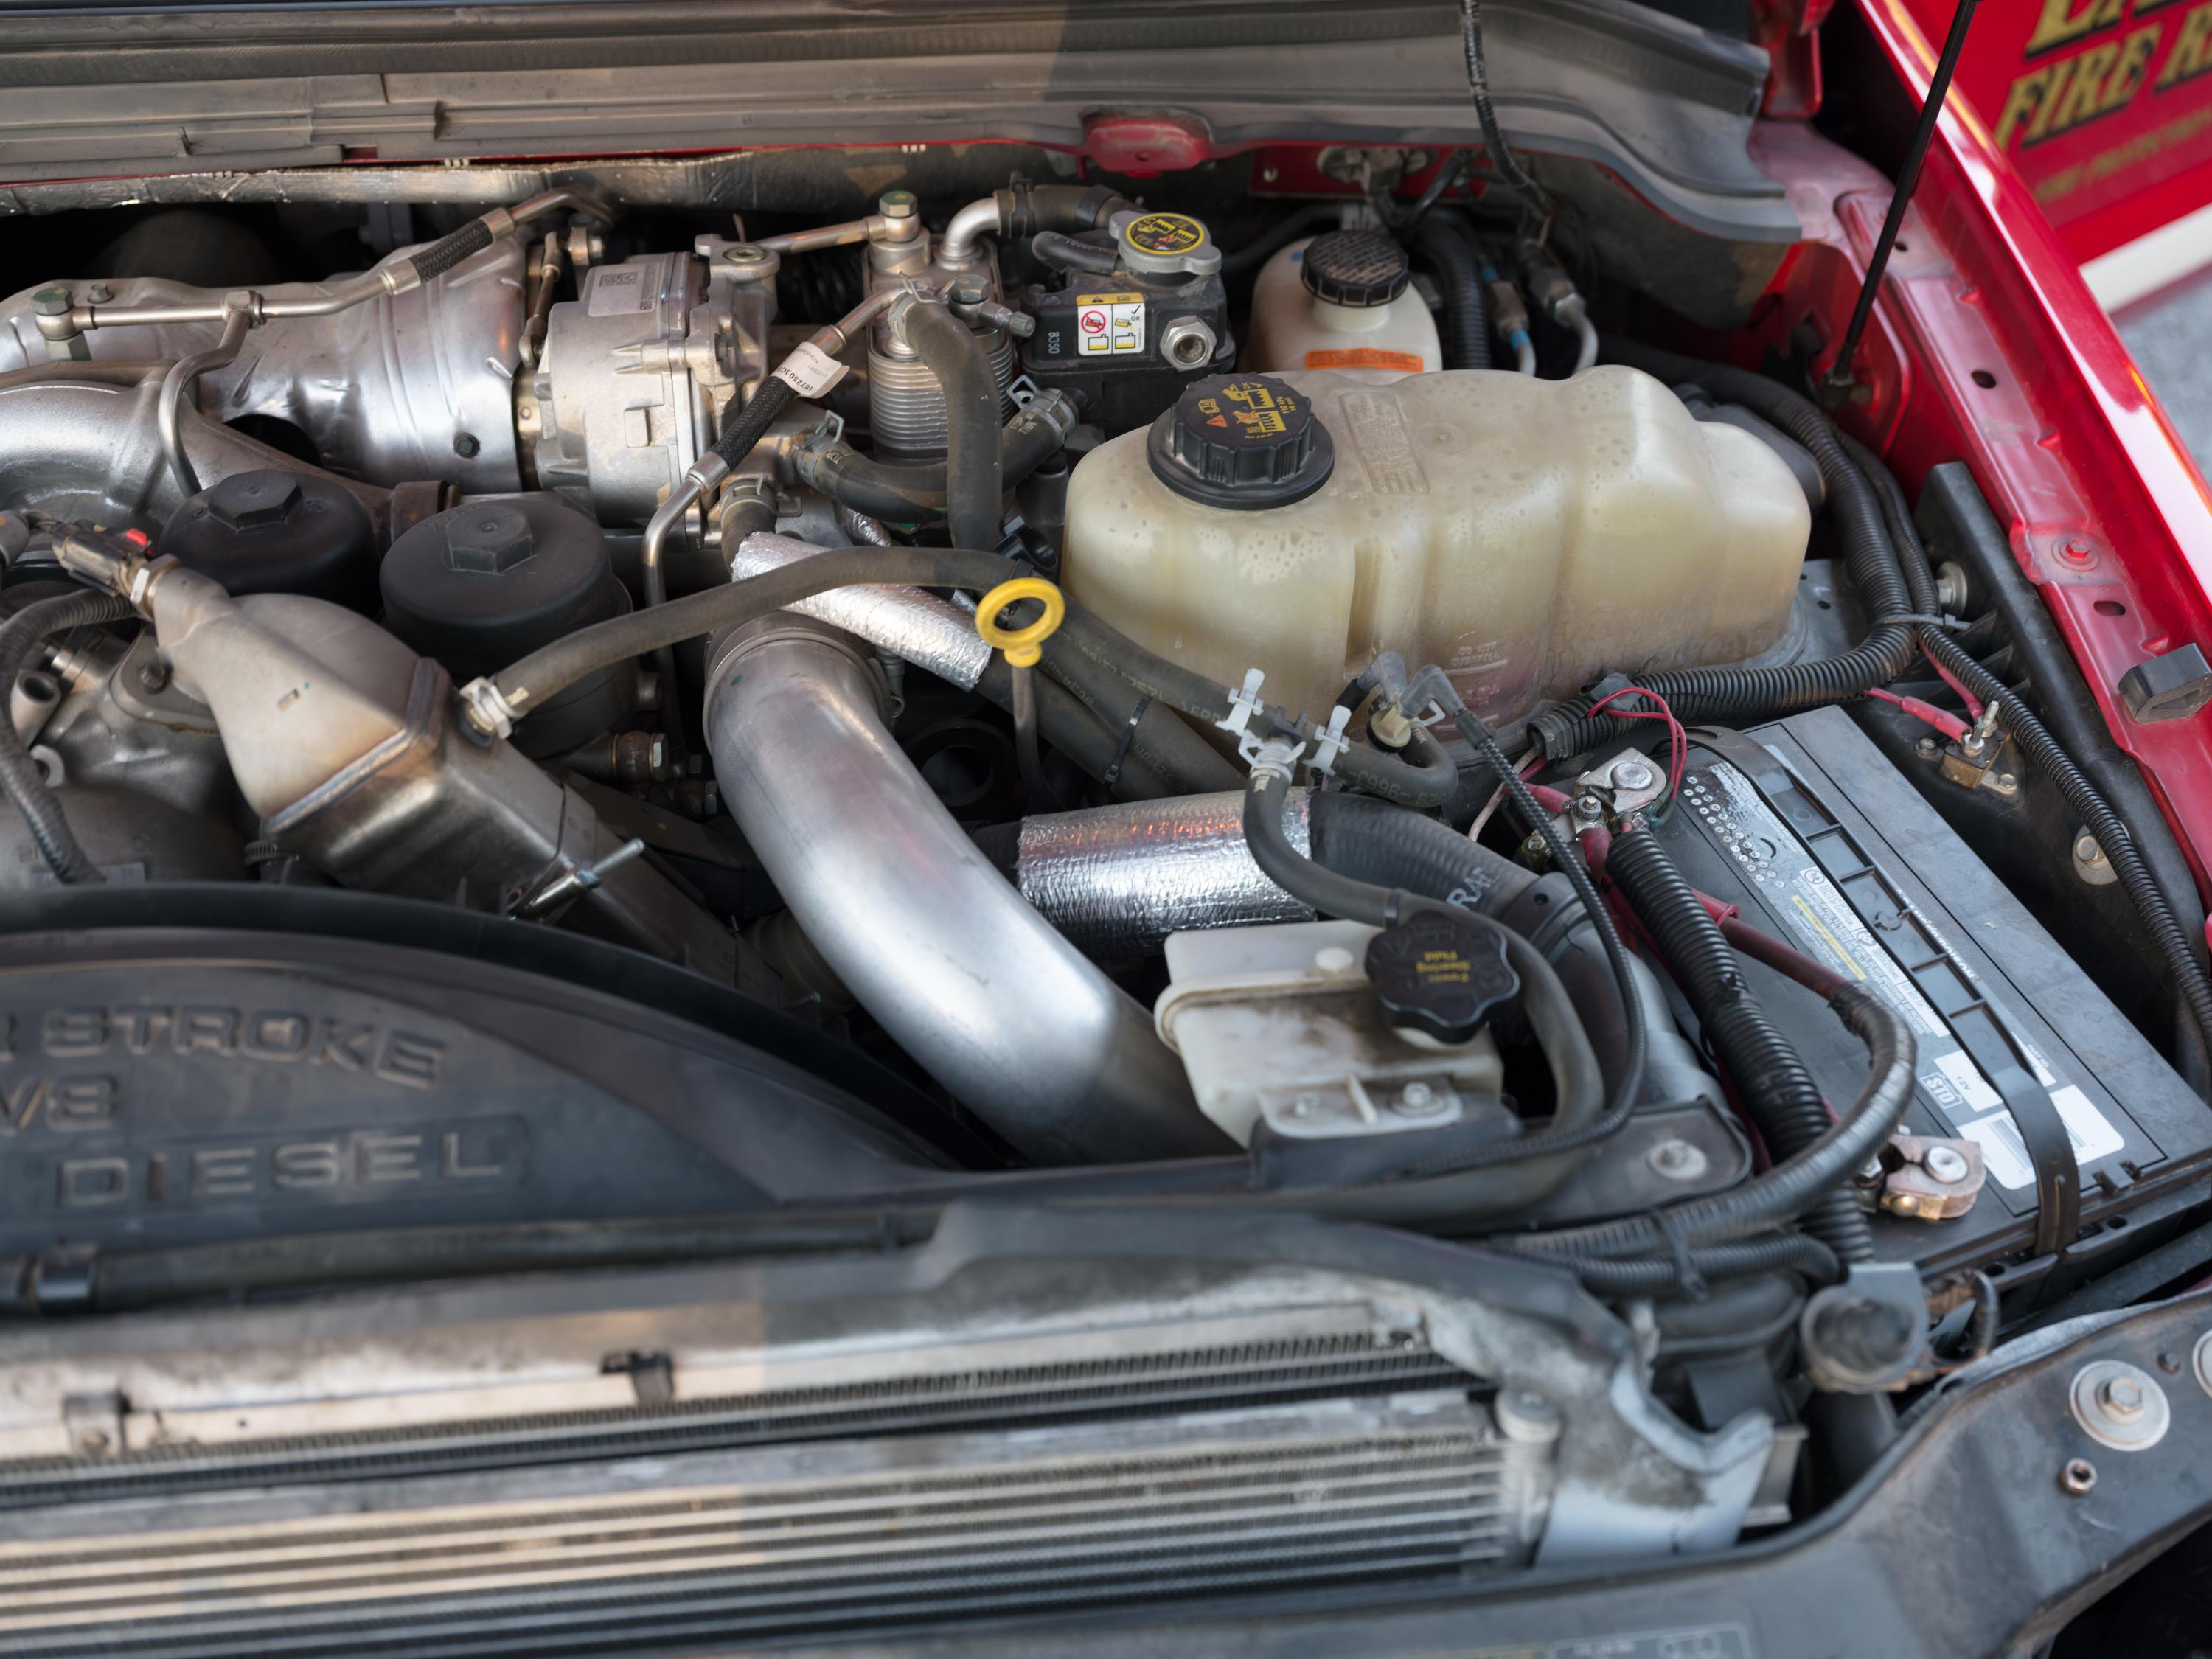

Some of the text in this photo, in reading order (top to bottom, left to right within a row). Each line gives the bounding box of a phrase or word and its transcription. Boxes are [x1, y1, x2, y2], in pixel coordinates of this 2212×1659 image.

[1993, 21, 2163, 151] FIRE
[1048, 331, 1060, 354] 8350
[42, 1004, 447, 1090] STROKE
[1926, 1077, 1955, 1104] STD
[1956, 1075, 1972, 1091] 12V
[58, 1132, 503, 1208] DIESEL
